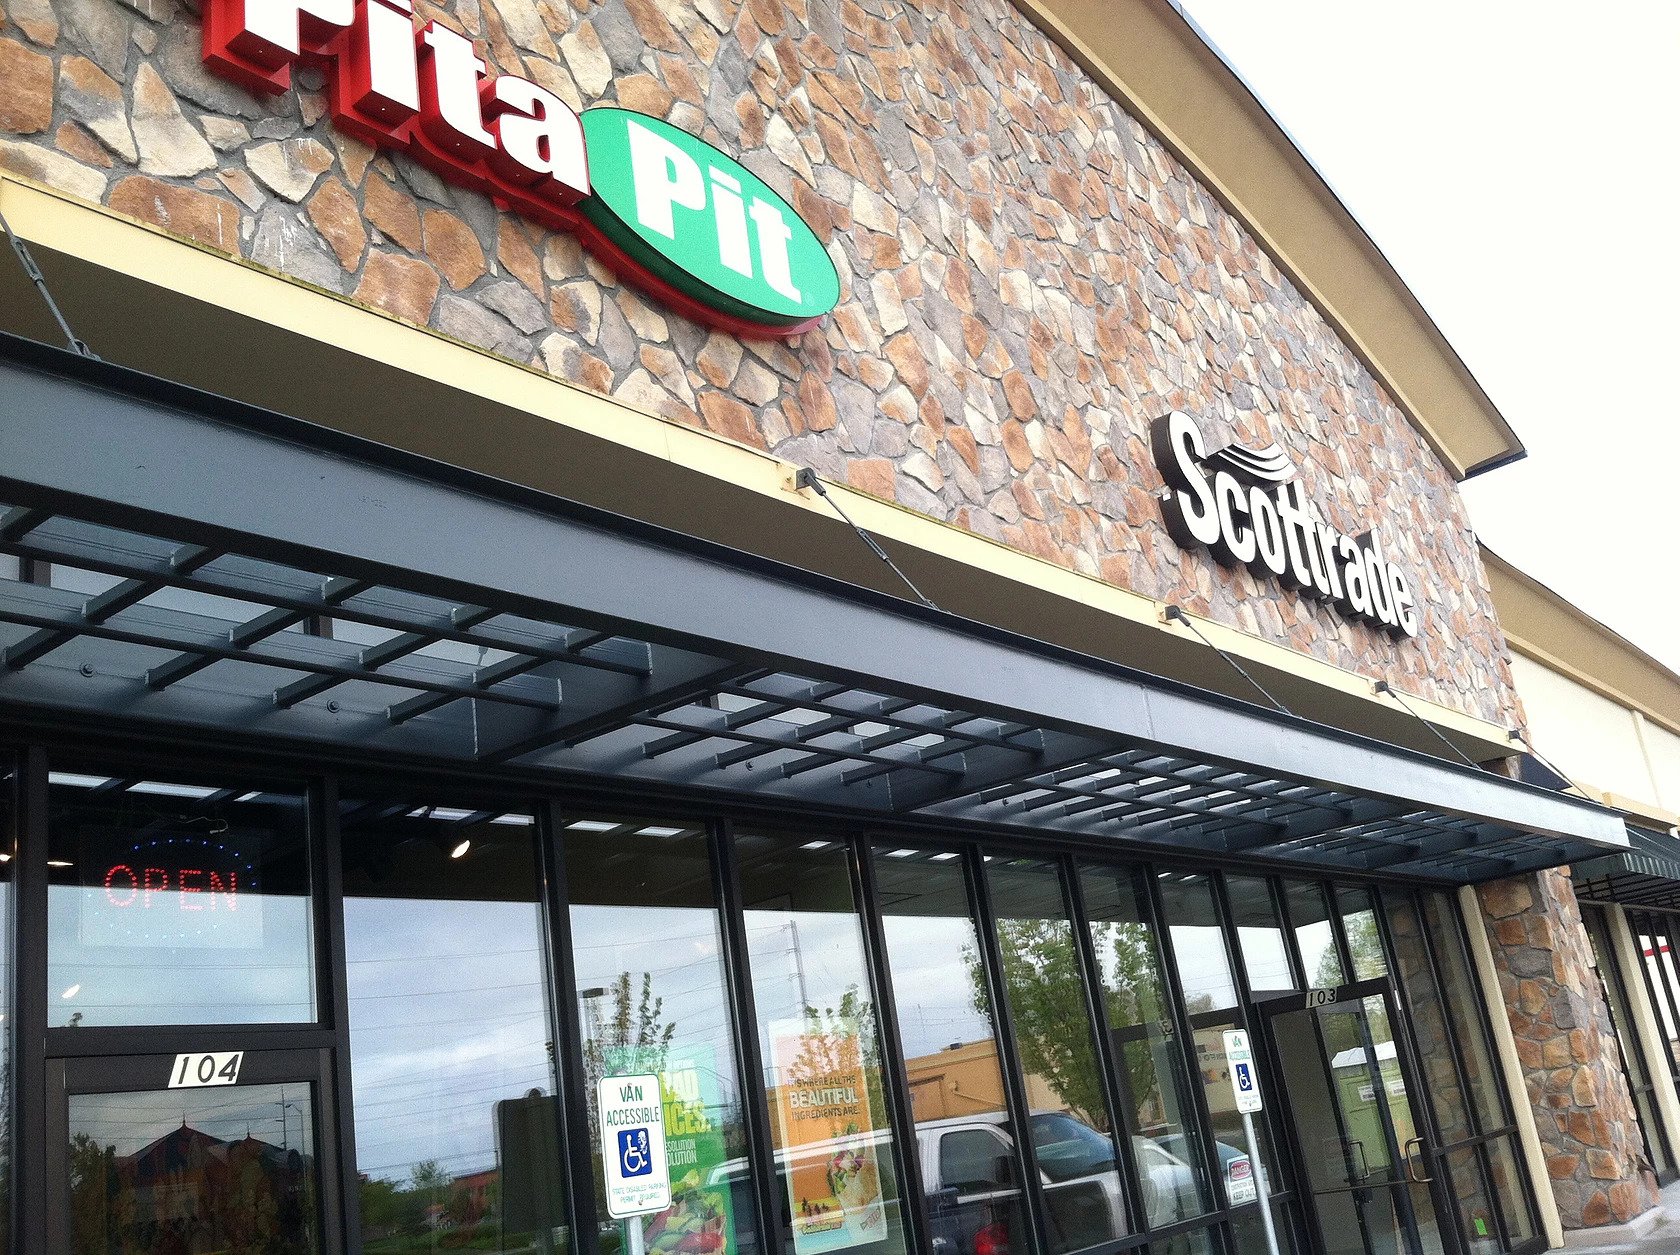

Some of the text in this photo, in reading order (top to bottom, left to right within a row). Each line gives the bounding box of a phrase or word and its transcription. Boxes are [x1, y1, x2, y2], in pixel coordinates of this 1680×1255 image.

[627, 118, 802, 304] Pit
[1165, 411, 1417, 638] Scottrade
[104, 864, 238, 911] OPEN
[1308, 989, 1336, 1006] 103
[178, 1054, 239, 1084] 104
[802, 1077, 828, 1087] WHERE
[829, 1076, 842, 1085] ALL
[842, 1075, 856, 1084] THE
[620, 1085, 643, 1102] VAN
[789, 1087, 859, 1109] BEAUTIFUL
[606, 1106, 660, 1126] ACCESSIBLE
[791, 1108, 842, 1121] INGREDIENTS
